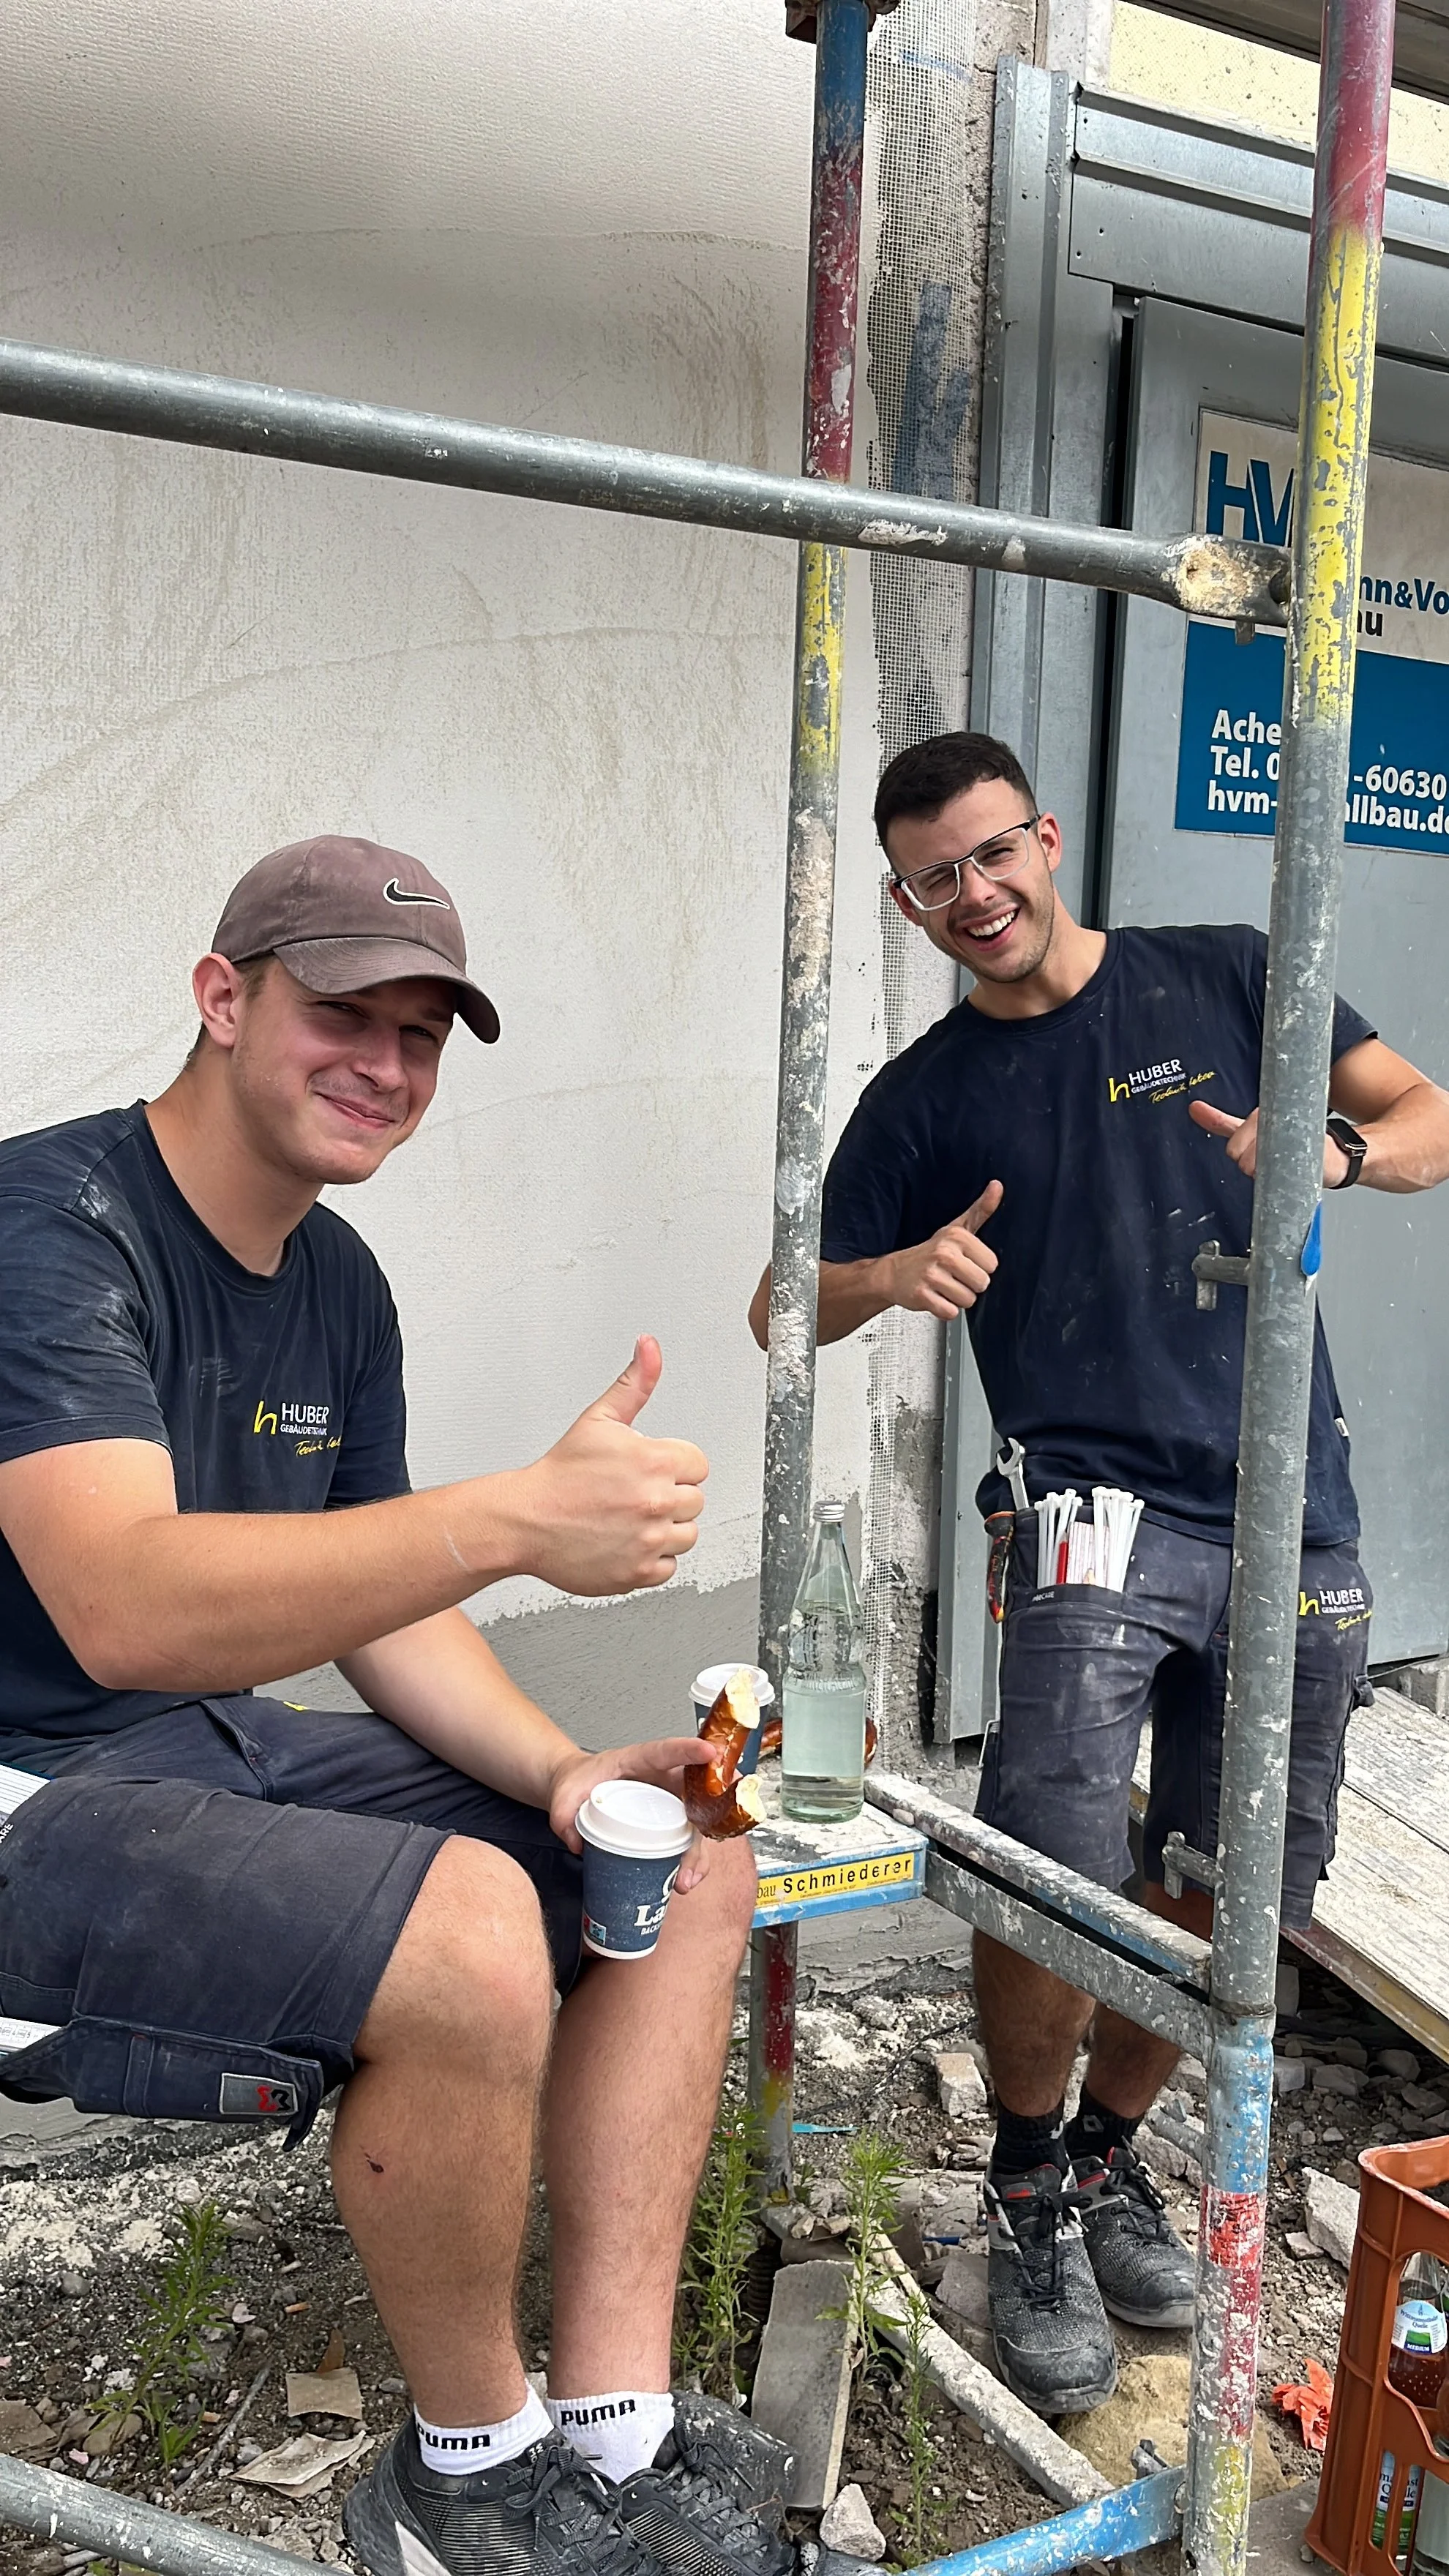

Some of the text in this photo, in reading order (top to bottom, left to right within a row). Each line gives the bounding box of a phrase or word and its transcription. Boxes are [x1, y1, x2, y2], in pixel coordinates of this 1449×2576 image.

[1207, 450, 1294, 548] HV
[1359, 575, 1449, 615] nn&Vo
[1211, 709, 1281, 746] Ache
[1210, 745, 1259, 779] Tel.
[1128, 1059, 1183, 1086] HUBER
[281, 1402, 329, 1424] HUBER
[1319, 1588, 1364, 1605] HUBER
[783, 1859, 911, 1894] Schmiederer
[561, 2399, 636, 2427] PUMA
[416, 2422, 491, 2451] PUMA
